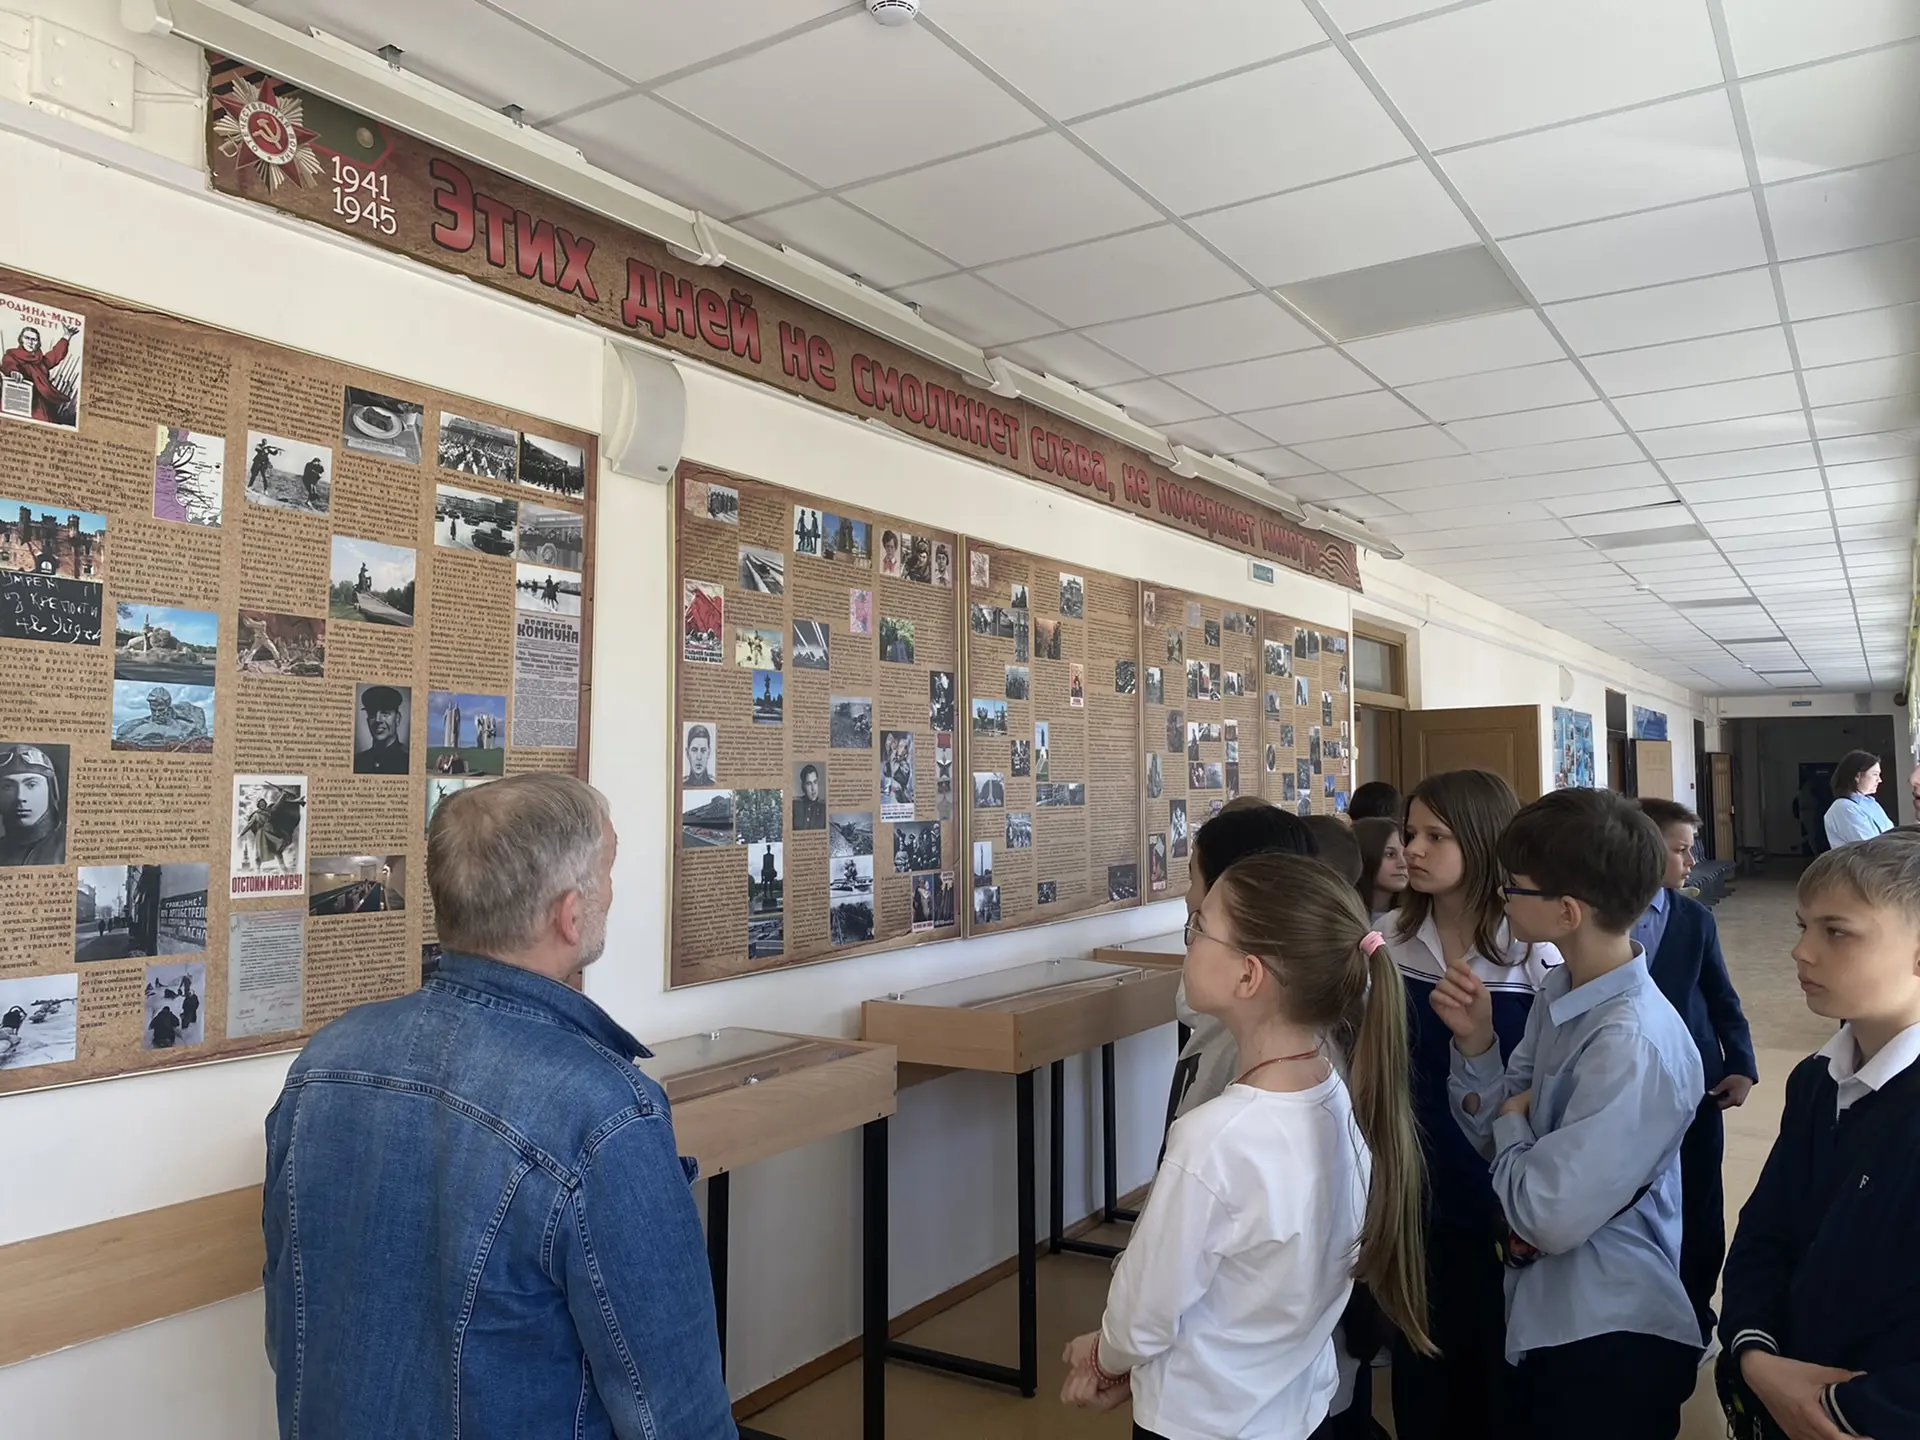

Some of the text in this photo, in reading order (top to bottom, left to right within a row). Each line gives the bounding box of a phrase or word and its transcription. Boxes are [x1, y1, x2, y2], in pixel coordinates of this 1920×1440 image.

[332, 155, 391, 204] 1941
[332, 186, 398, 236] 1945
[0, 298, 82, 327] РОДИНА-МАТЬ
[20, 314, 58, 330] ЗОВЕТ!
[428, 157, 600, 304] Этих
[622, 257, 762, 364] дней
[778, 320, 837, 392] не
[850, 352, 1021, 460] смолкнет
[1030, 425, 1116, 502] слава,
[1121, 462, 1151, 506] не
[1155, 476, 1257, 547] померкнет
[517, 624, 579, 643] КОММУНА
[232, 874, 302, 893] ОТСТОИМ МОСКВУ!
